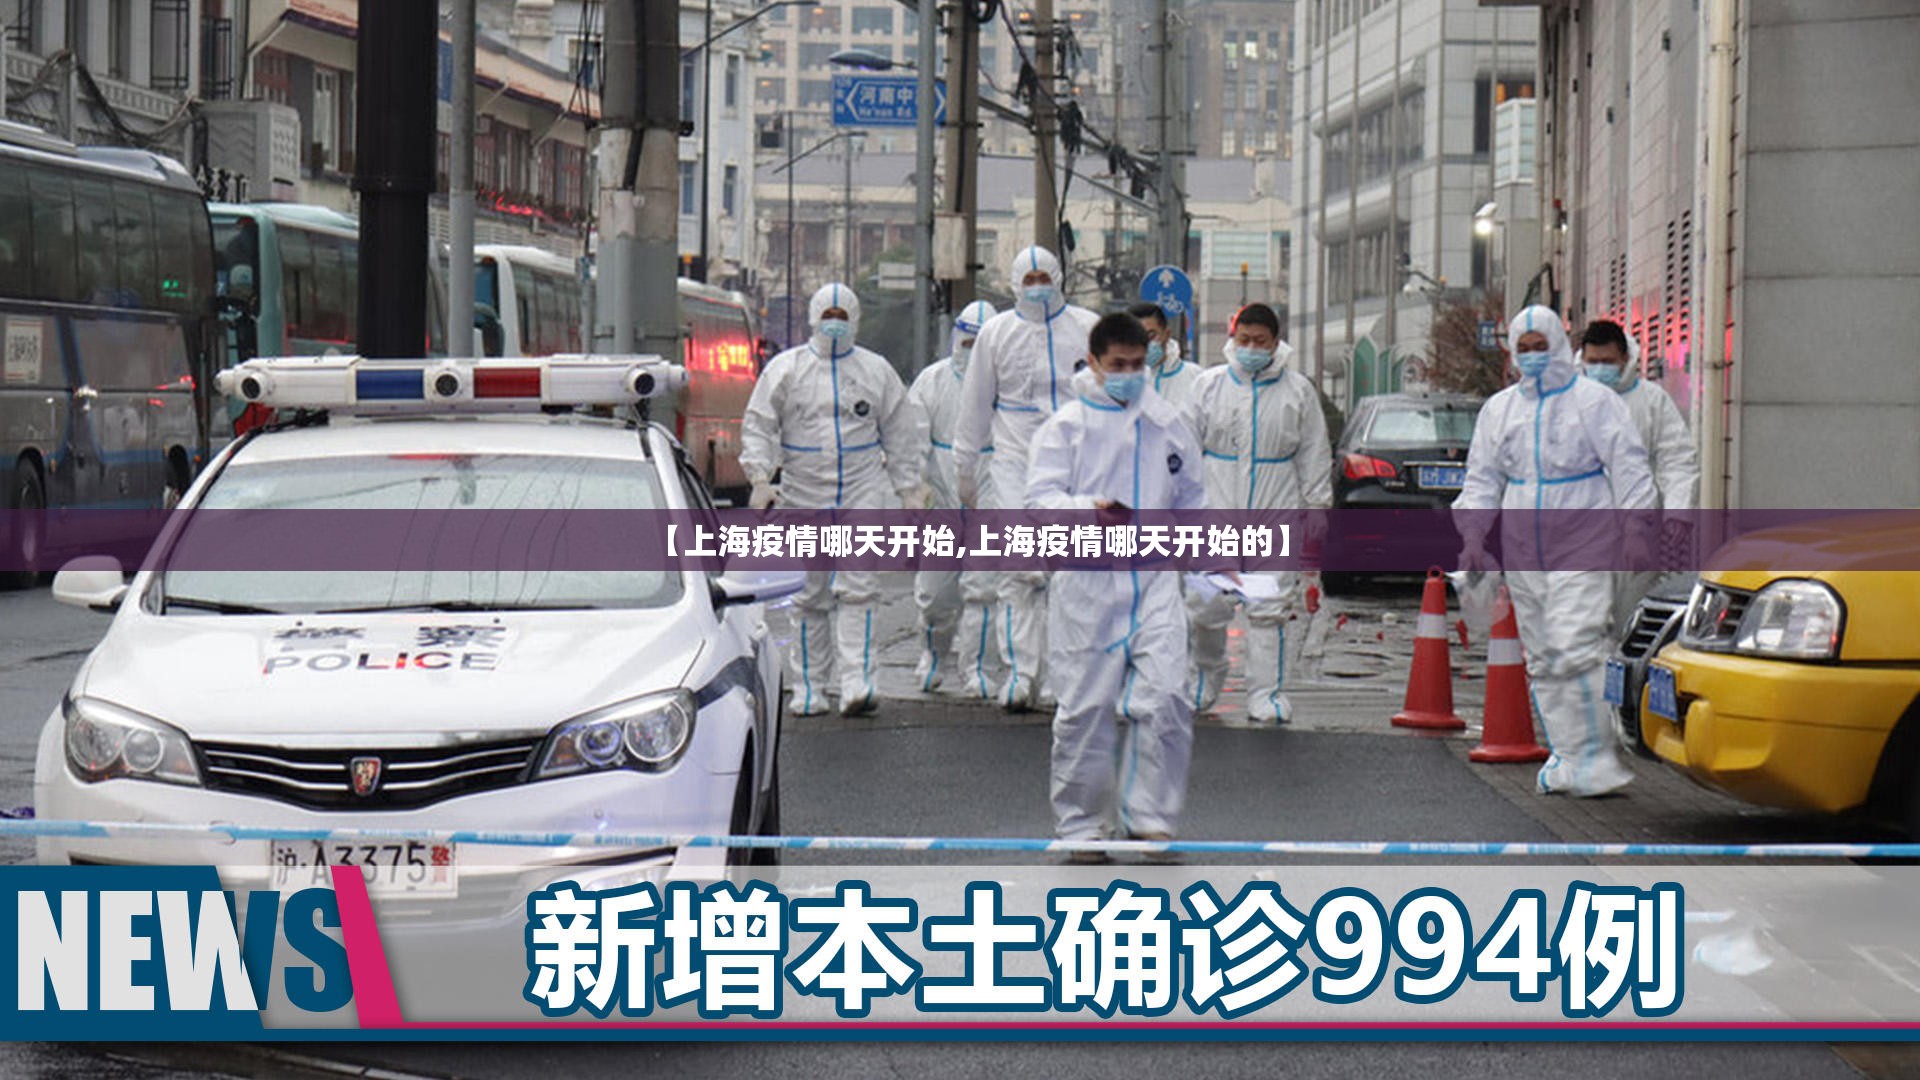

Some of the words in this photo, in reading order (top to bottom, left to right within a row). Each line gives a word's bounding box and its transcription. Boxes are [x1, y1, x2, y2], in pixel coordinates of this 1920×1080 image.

[860, 86, 919, 105] 河南中
[274, 625, 507, 652] 警察
[263, 652, 500, 675] POLICE
